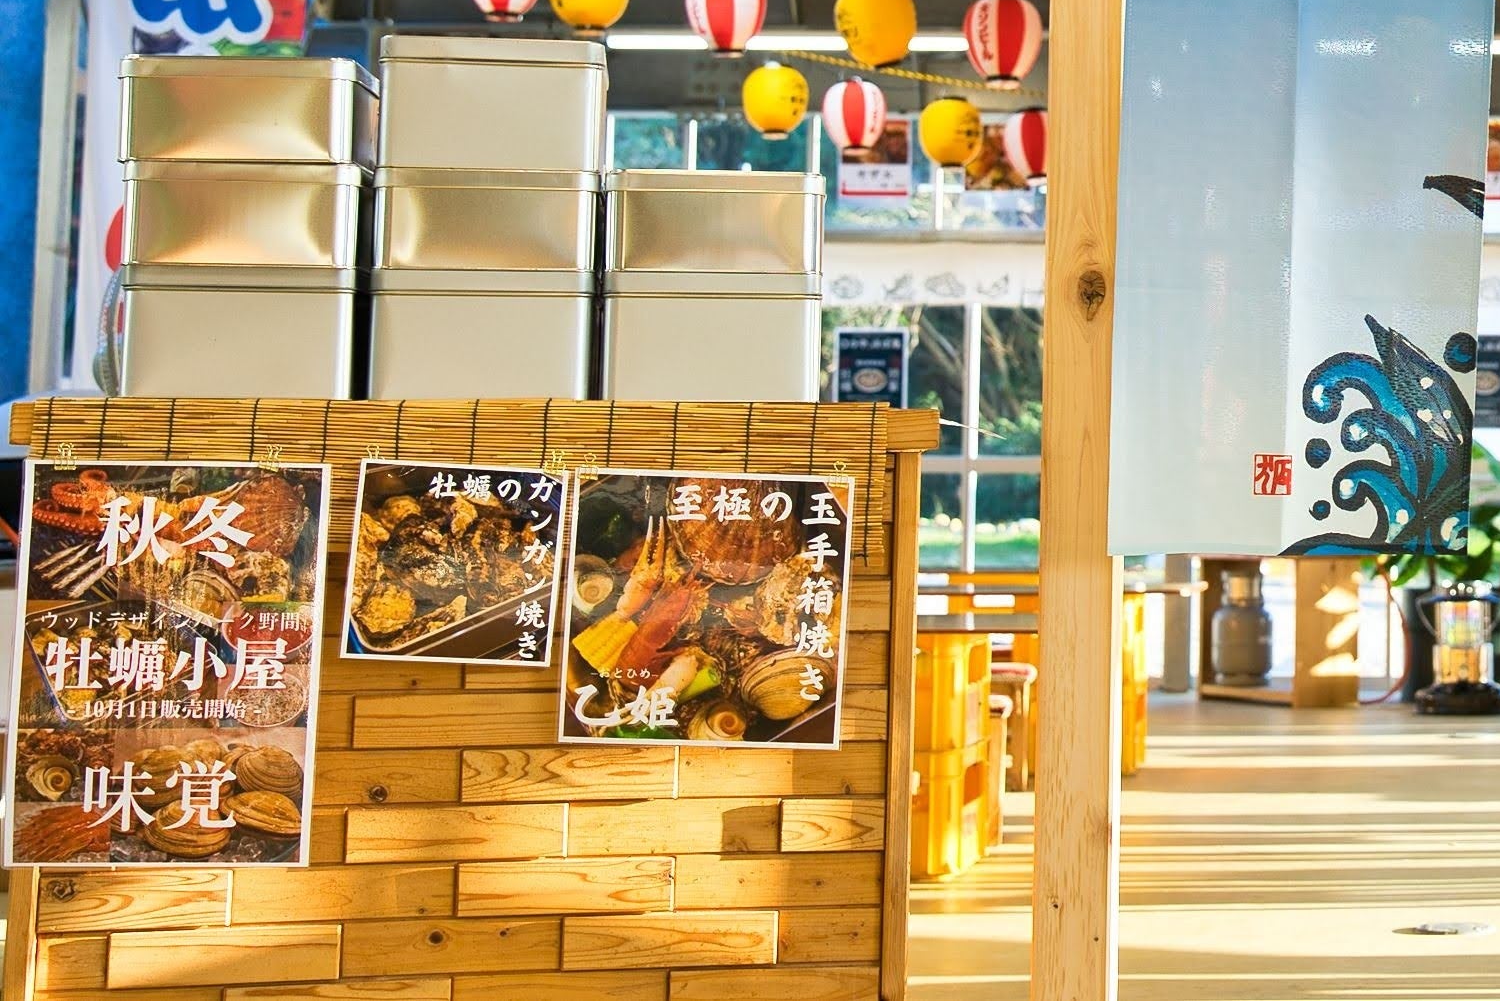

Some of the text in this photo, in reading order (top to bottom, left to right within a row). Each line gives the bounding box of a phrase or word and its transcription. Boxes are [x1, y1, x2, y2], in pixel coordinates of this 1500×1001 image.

[429, 472, 522, 501] 牡蠣の
[667, 484, 793, 524] 至極の
[97, 495, 255, 568] 秋冬
[515, 473, 557, 661] ガンガン焼き
[793, 489, 843, 702] 玉手箱焼き
[39, 611, 301, 632] ウッドデザインパーク野間
[45, 636, 289, 692] 牡蠣小屋
[597, 666, 653, 680] おとひめ
[83, 698, 248, 720] 10月1日販売開始
[573, 684, 680, 729] 乙姫
[83, 759, 237, 832] 味覚
